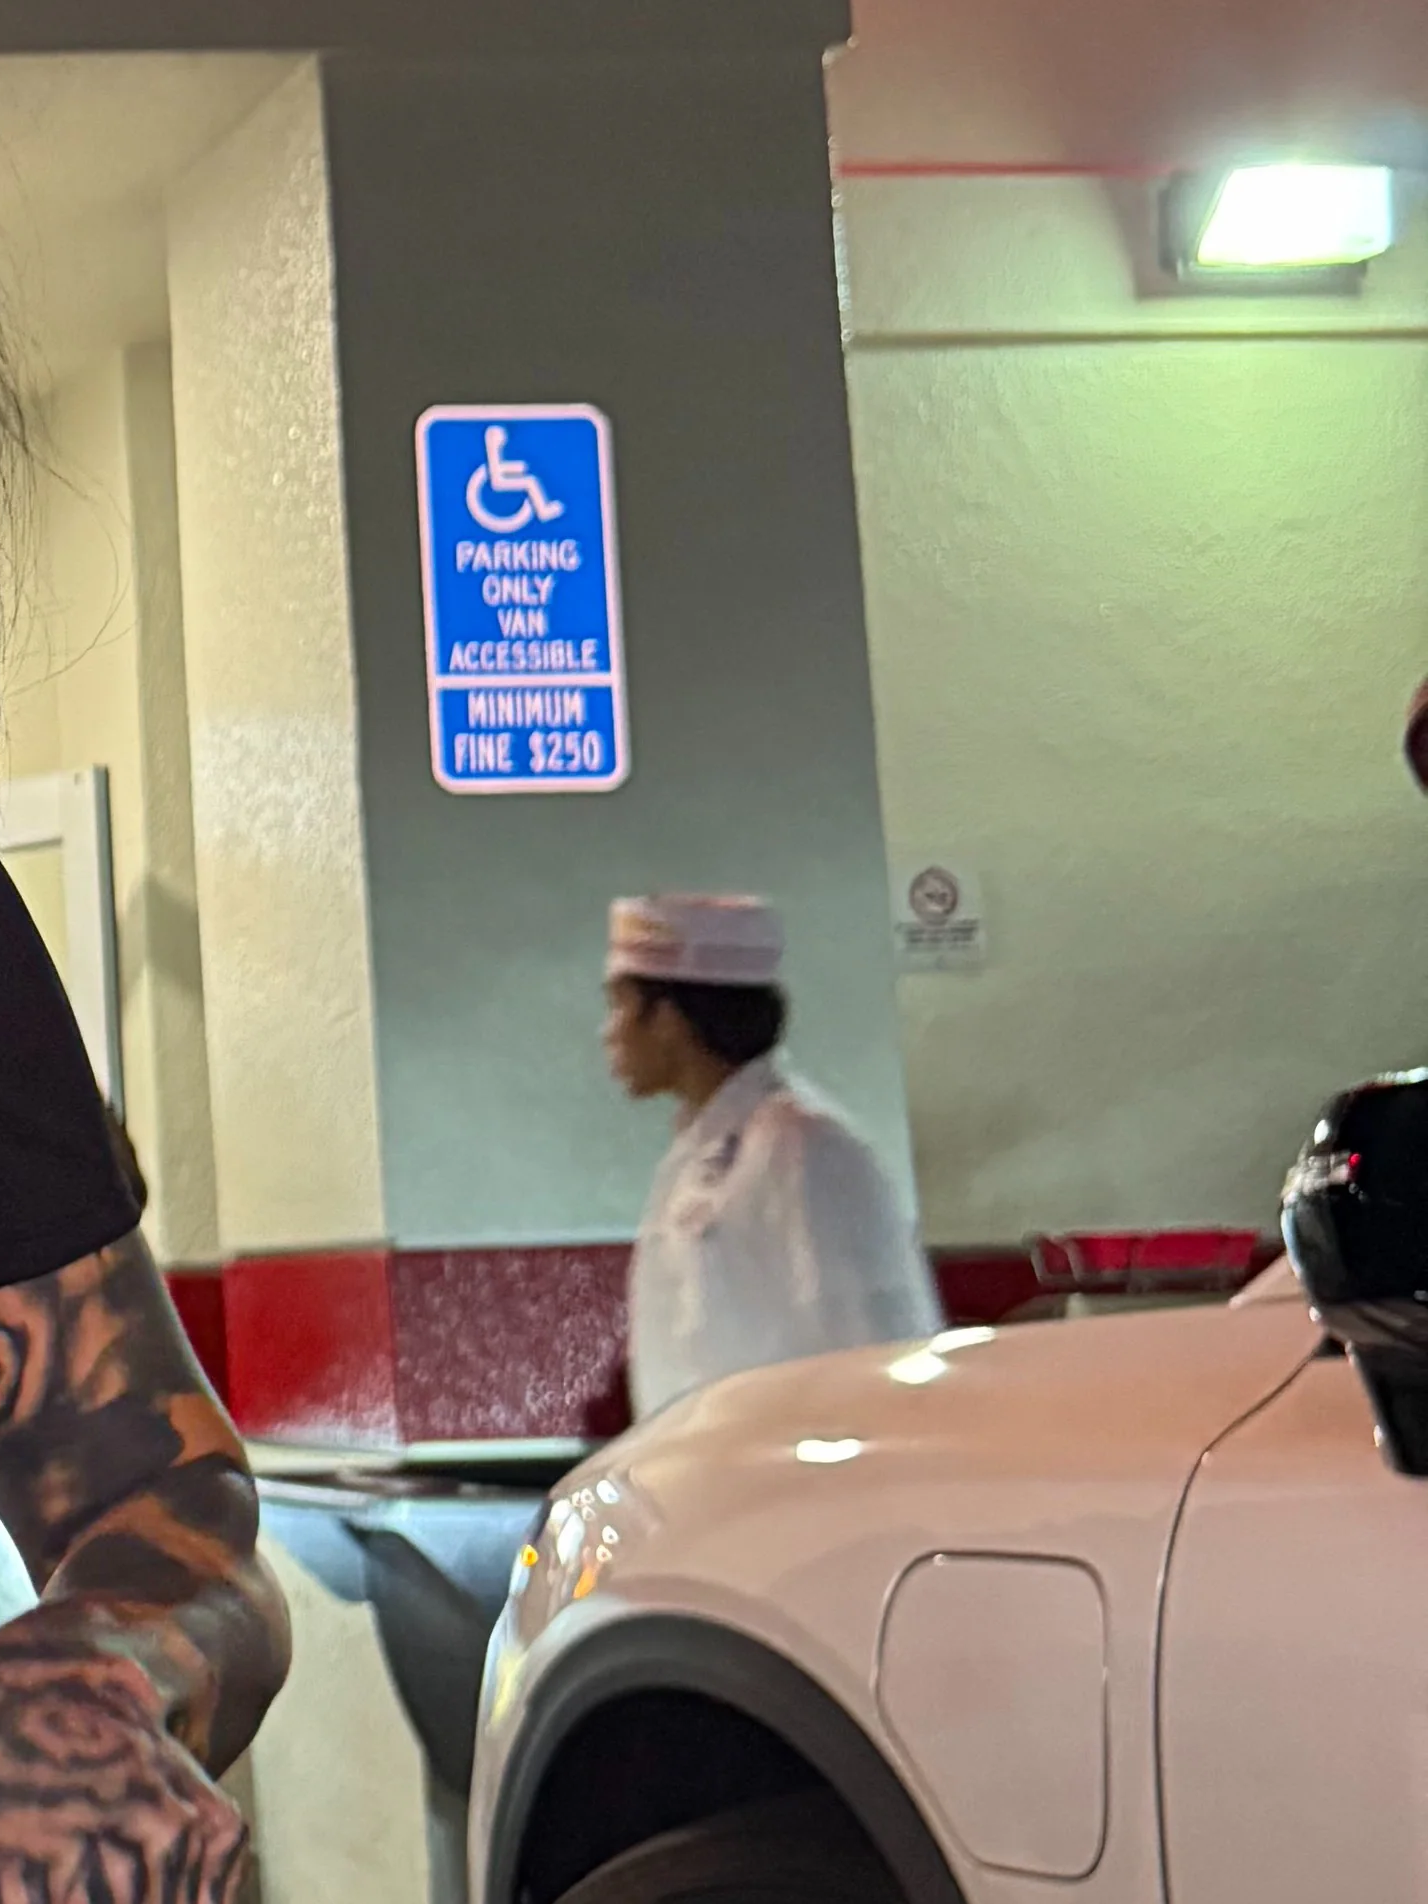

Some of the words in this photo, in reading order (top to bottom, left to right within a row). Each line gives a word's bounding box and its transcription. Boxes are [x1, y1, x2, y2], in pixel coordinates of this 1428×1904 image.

[455, 540, 581, 572] PARKING
[483, 574, 554, 607] ONLY
[497, 608, 546, 638] VAN
[449, 639, 598, 672] ACCESSIBLE
[468, 689, 585, 729] MINIMUM
[453, 732, 514, 774] FINE
[528, 729, 602, 773] $250
